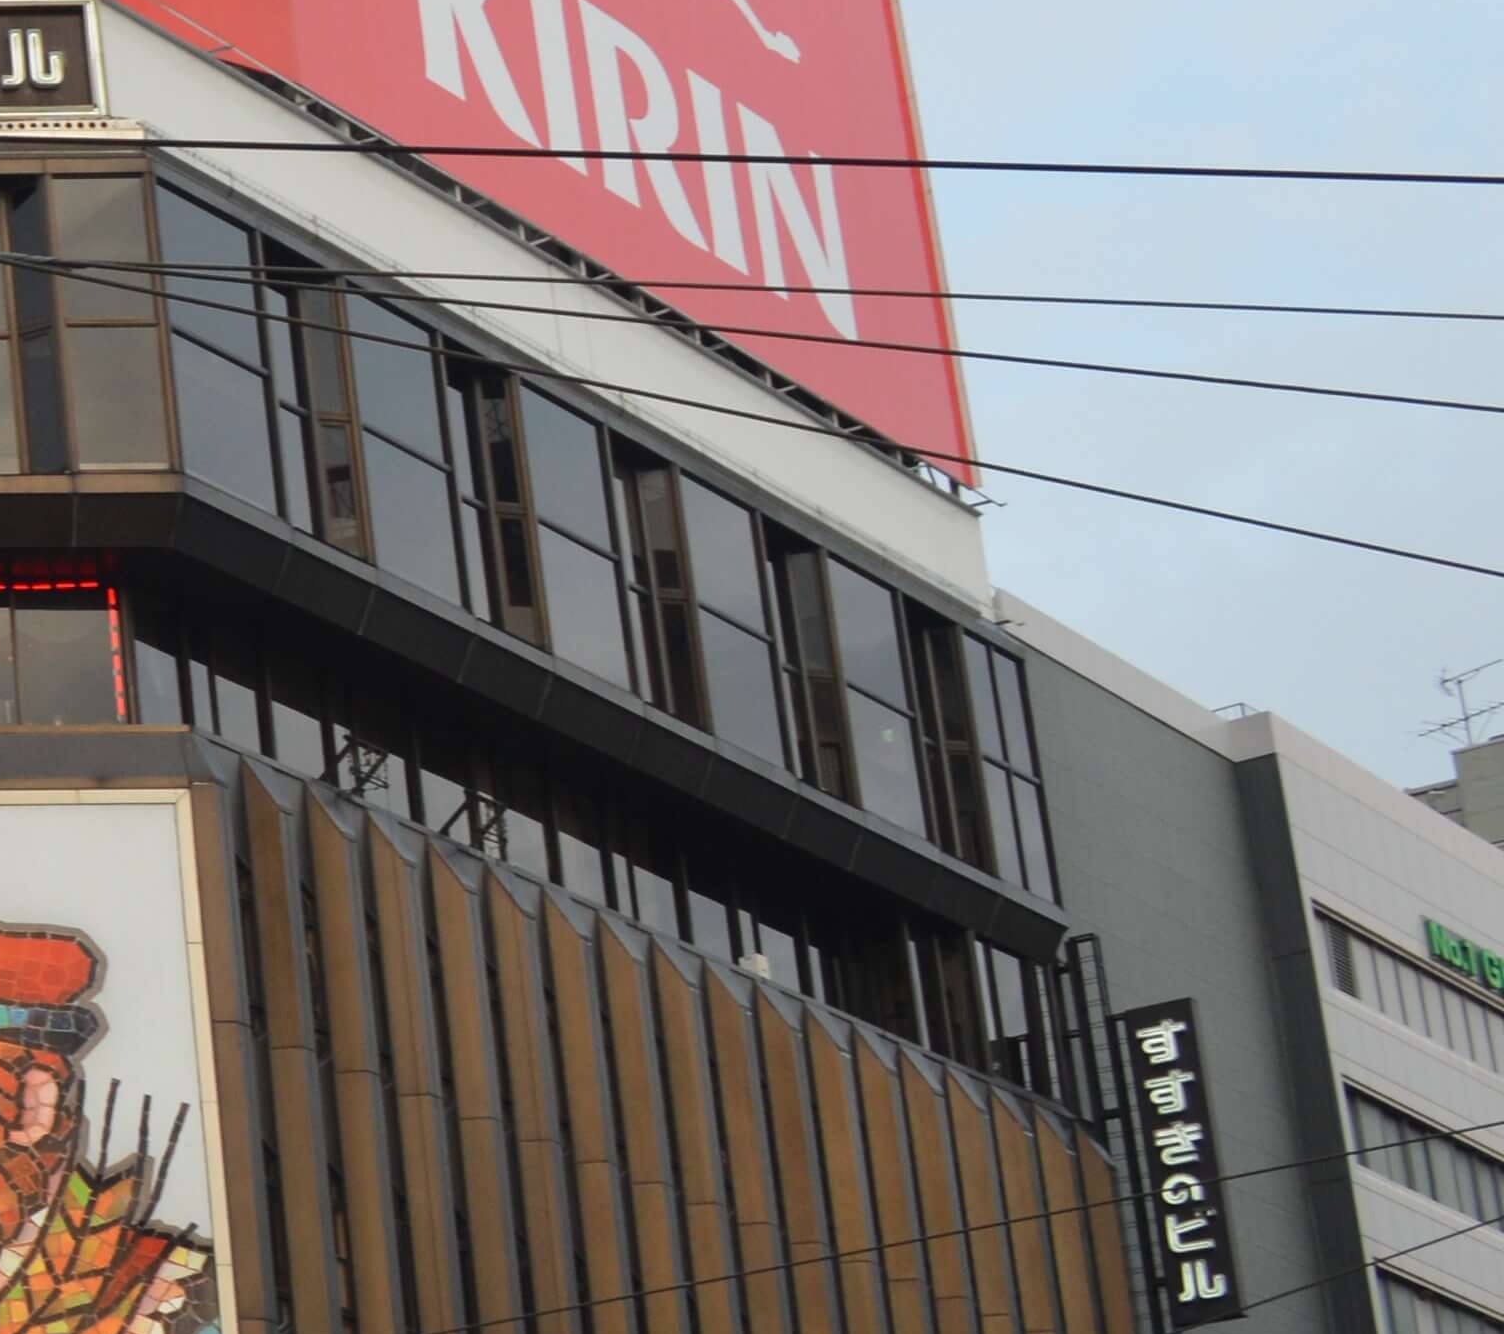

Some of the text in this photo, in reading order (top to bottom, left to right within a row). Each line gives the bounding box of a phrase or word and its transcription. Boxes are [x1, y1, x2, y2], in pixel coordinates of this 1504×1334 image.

[1136, 1019, 1227, 1303] すすきのビル
